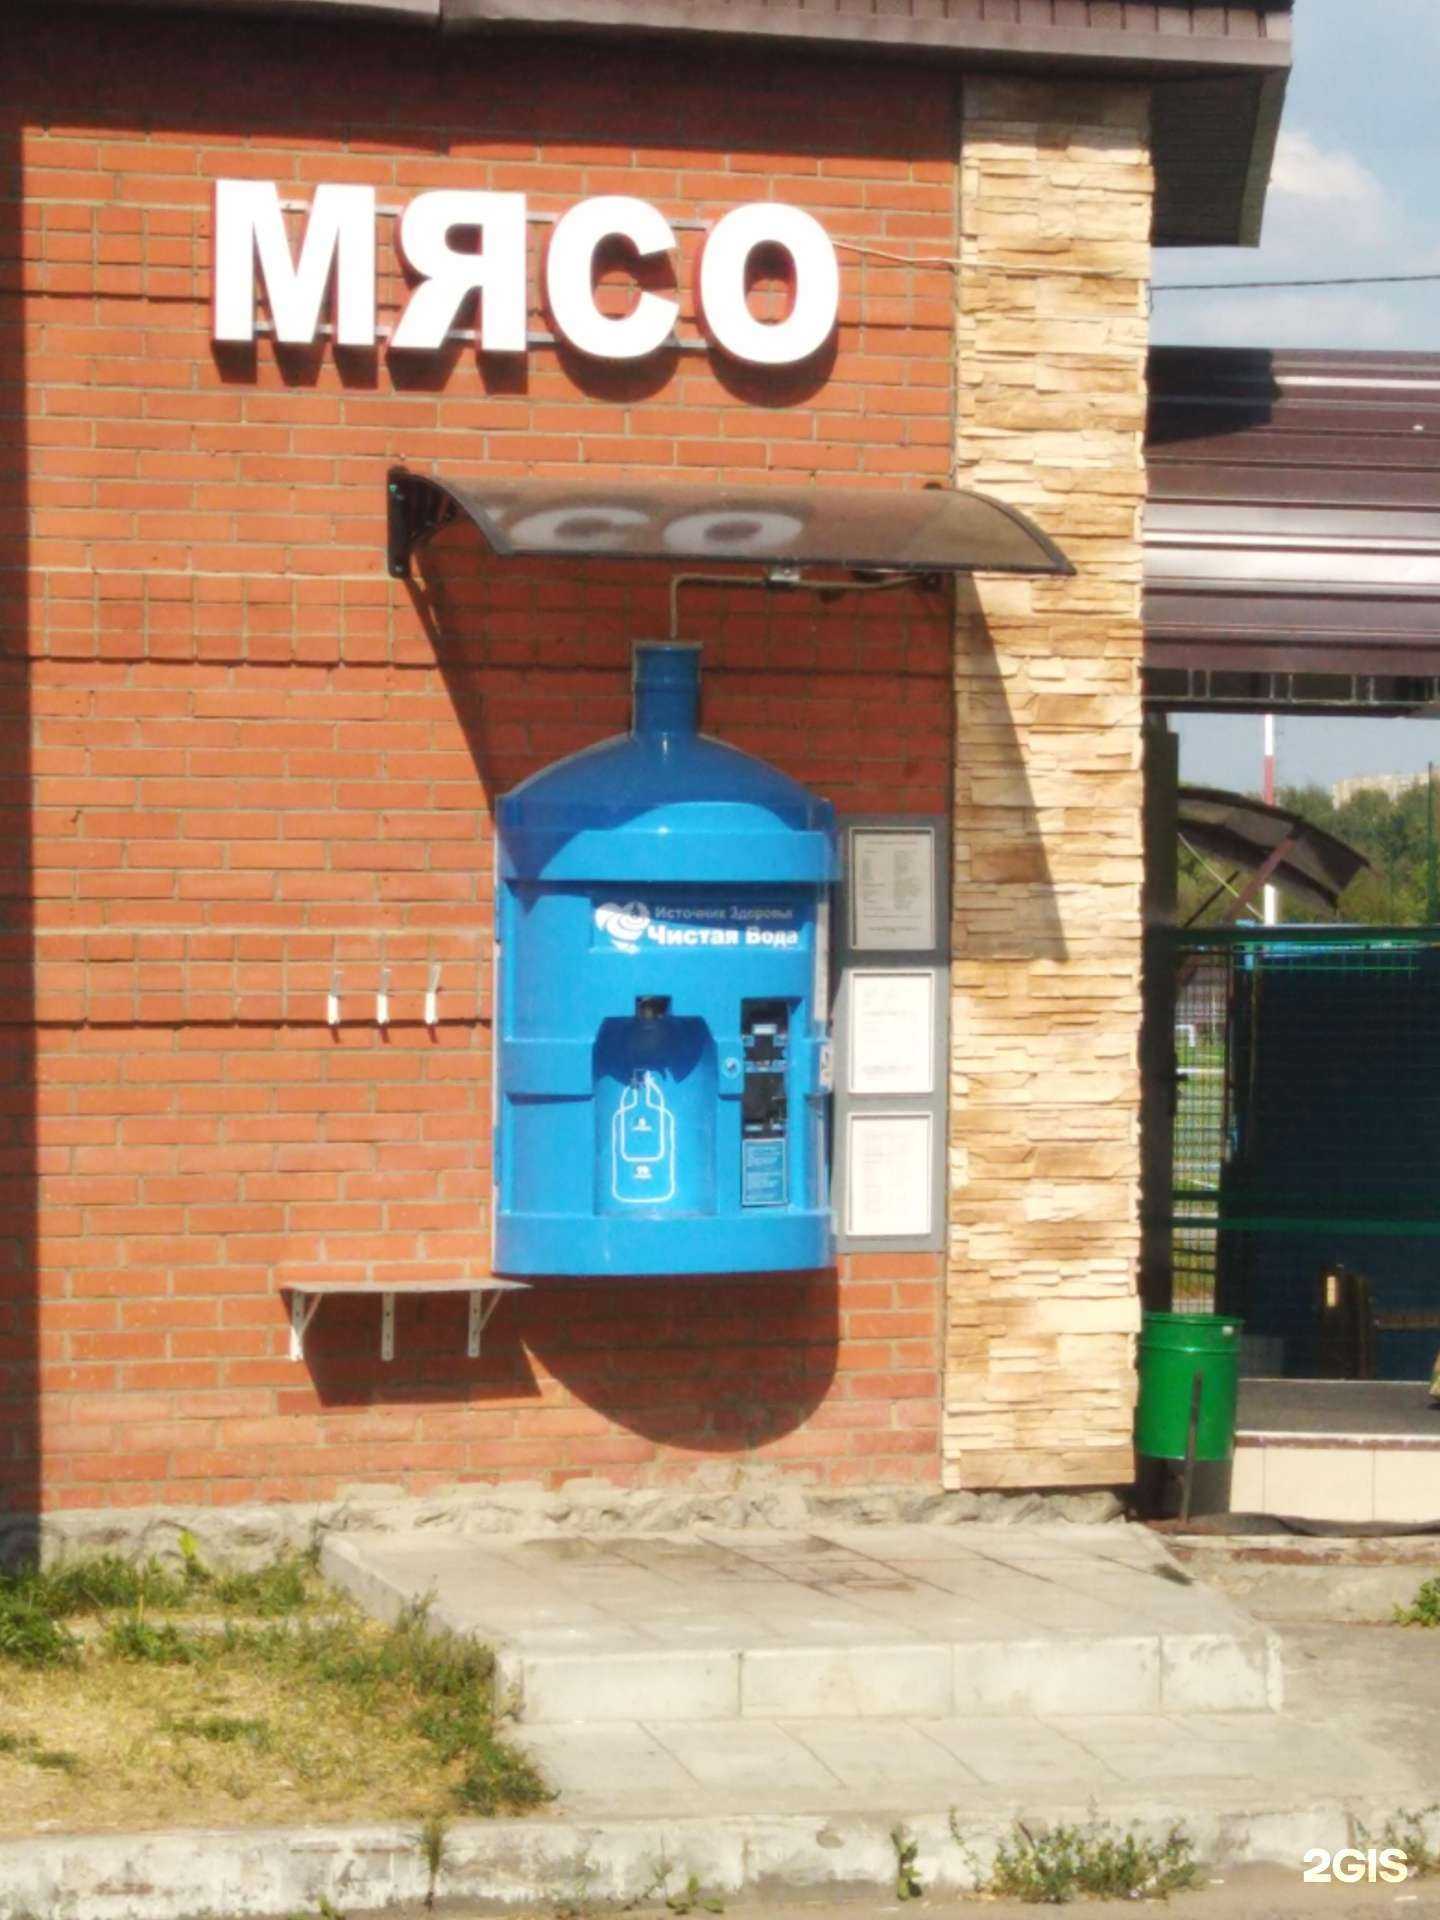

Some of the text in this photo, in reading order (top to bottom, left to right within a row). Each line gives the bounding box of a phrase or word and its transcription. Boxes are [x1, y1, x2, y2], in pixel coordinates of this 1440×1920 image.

[214, 179, 839, 365] МЯСО
[648, 925, 799, 949] Чистая Вода
